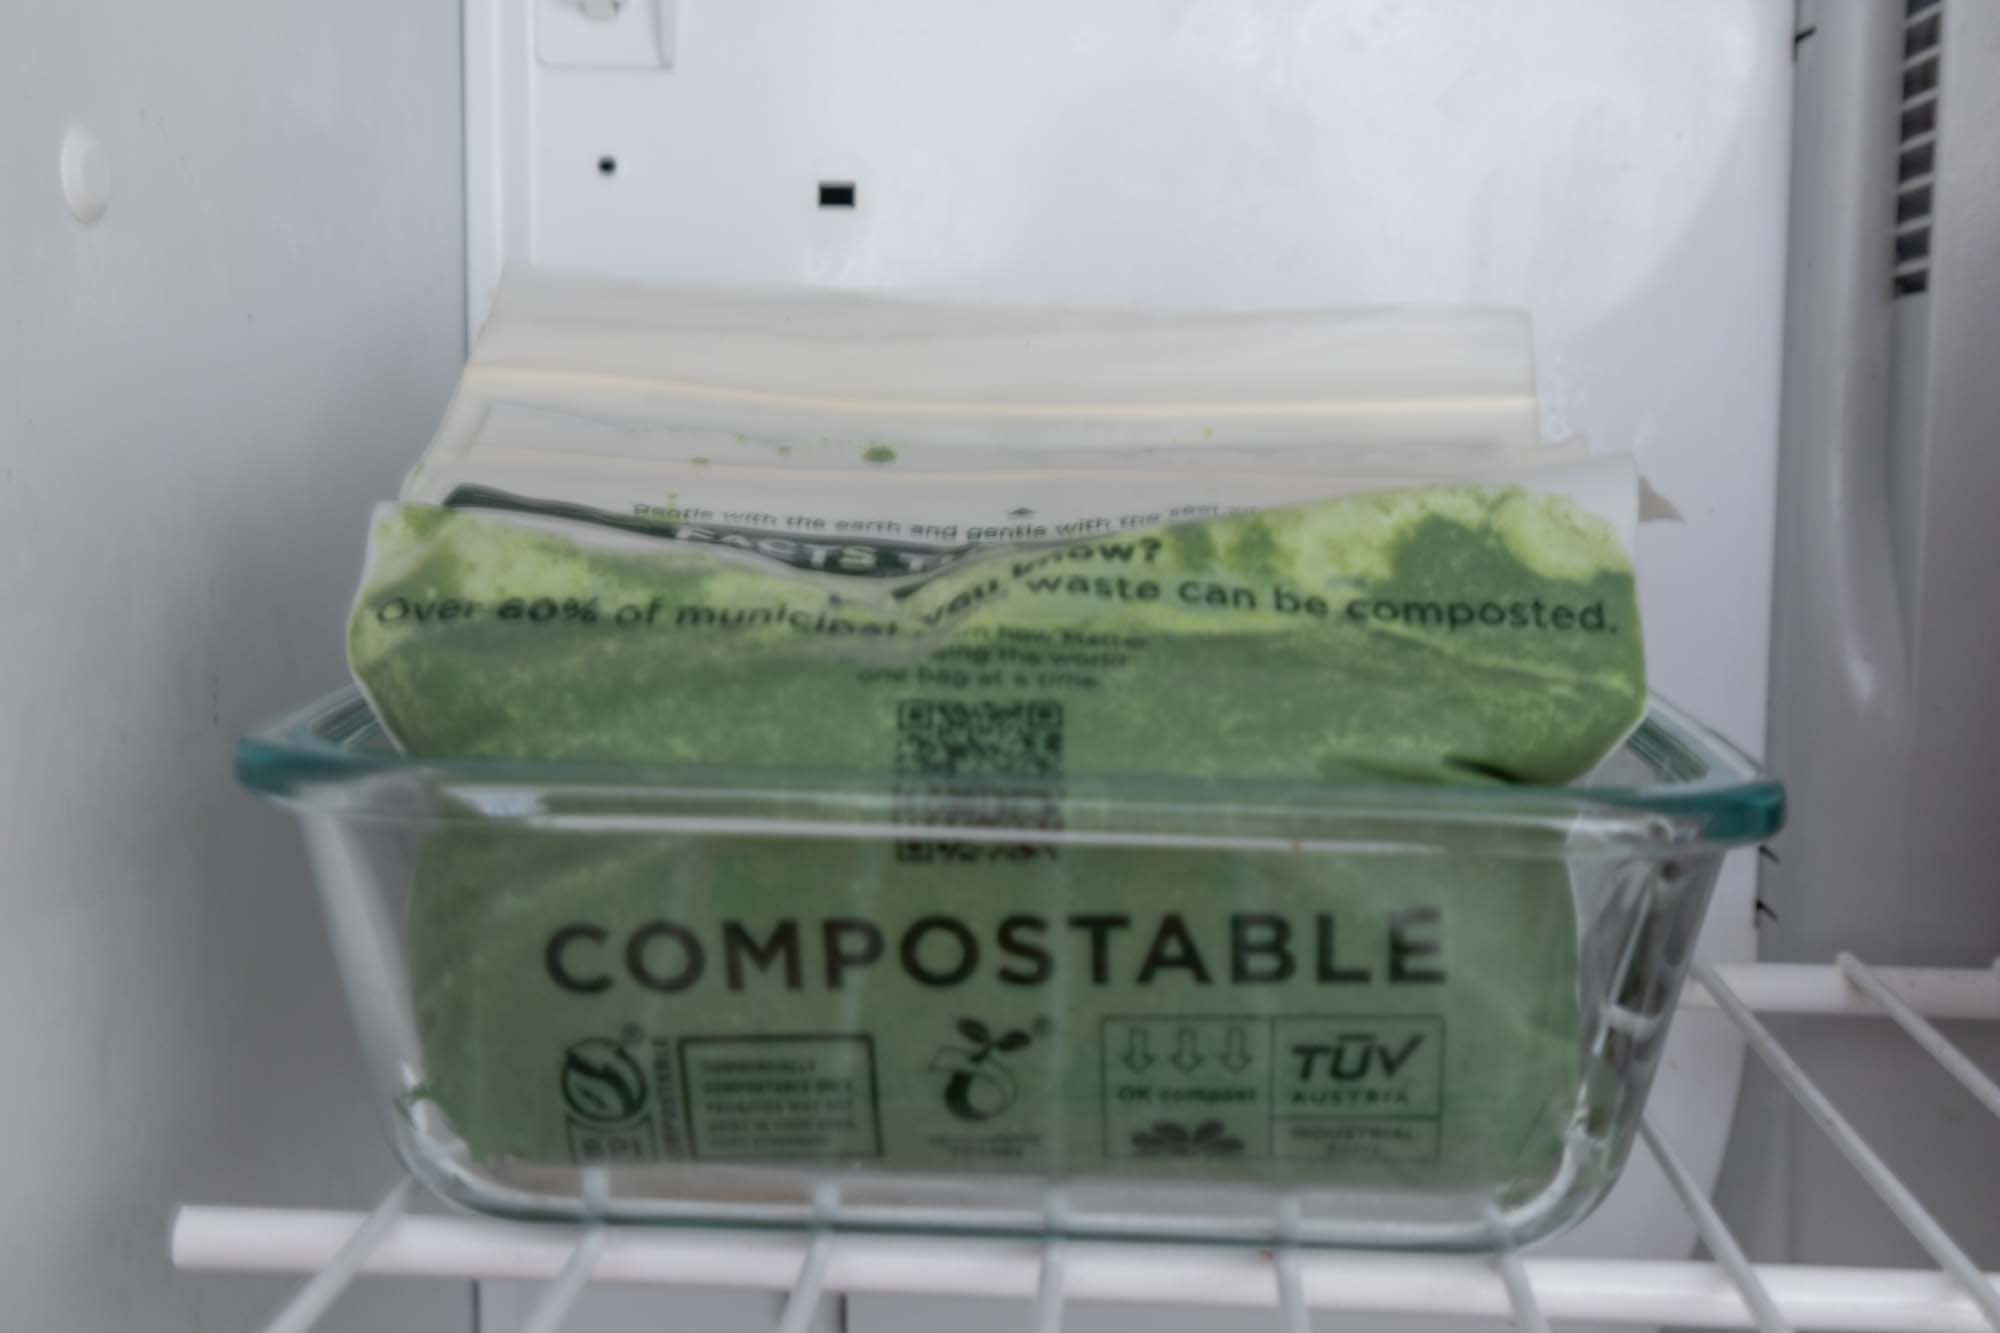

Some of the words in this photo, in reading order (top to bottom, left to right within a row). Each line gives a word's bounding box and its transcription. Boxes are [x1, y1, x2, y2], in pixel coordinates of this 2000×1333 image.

[909, 520, 958, 539] and
[966, 522, 1047, 541] gentle
[1055, 516, 1111, 537] with
[377, 595, 474, 624] Over
[497, 596, 599, 625] 60%
[616, 597, 660, 626] of
[1026, 574, 1161, 603] waste
[1178, 578, 1257, 612] can
[1274, 585, 1330, 619] be
[1345, 596, 1619, 635] composted.
[545, 907, 1446, 995] COMPOSTABLE
[1116, 1085, 1153, 1103] OK
[1290, 1089, 1411, 1105] AUSTRIA
